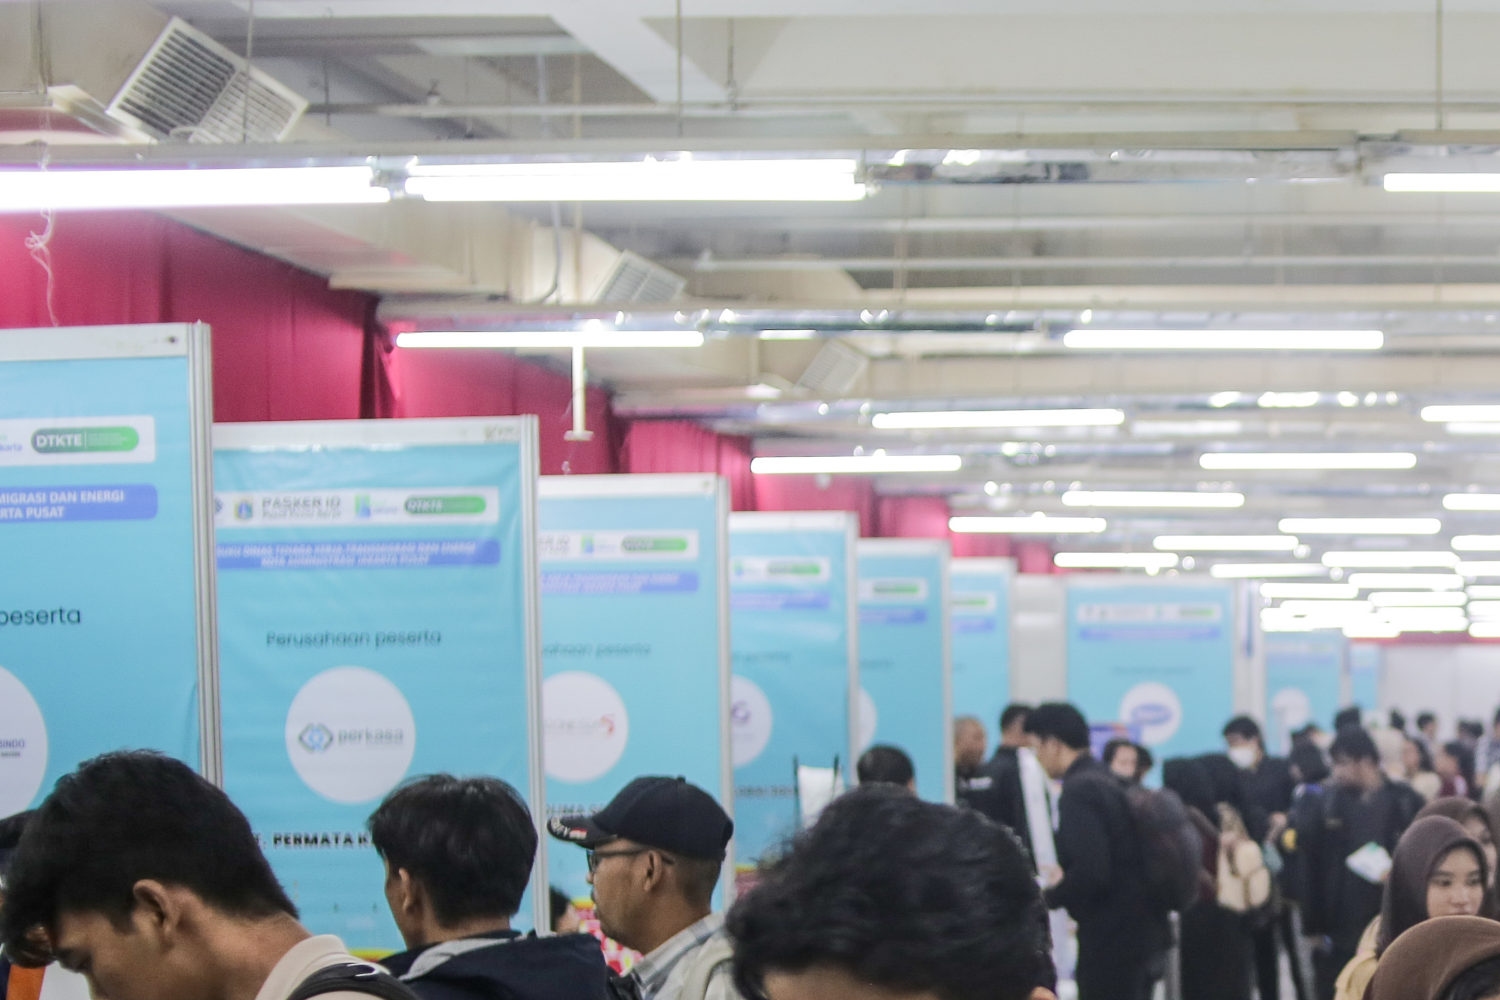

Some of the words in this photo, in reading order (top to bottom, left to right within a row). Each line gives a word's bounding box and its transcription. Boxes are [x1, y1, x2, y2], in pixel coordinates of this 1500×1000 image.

[35, 433, 83, 448] DTKTE
[50, 490, 78, 505] DAN
[80, 488, 126, 504] ENERGI
[26, 505, 66, 520] PUSAT
[265, 630, 370, 648] Perusahaan
[374, 630, 442, 650] peserta
[272, 832, 354, 846] PERMATA
